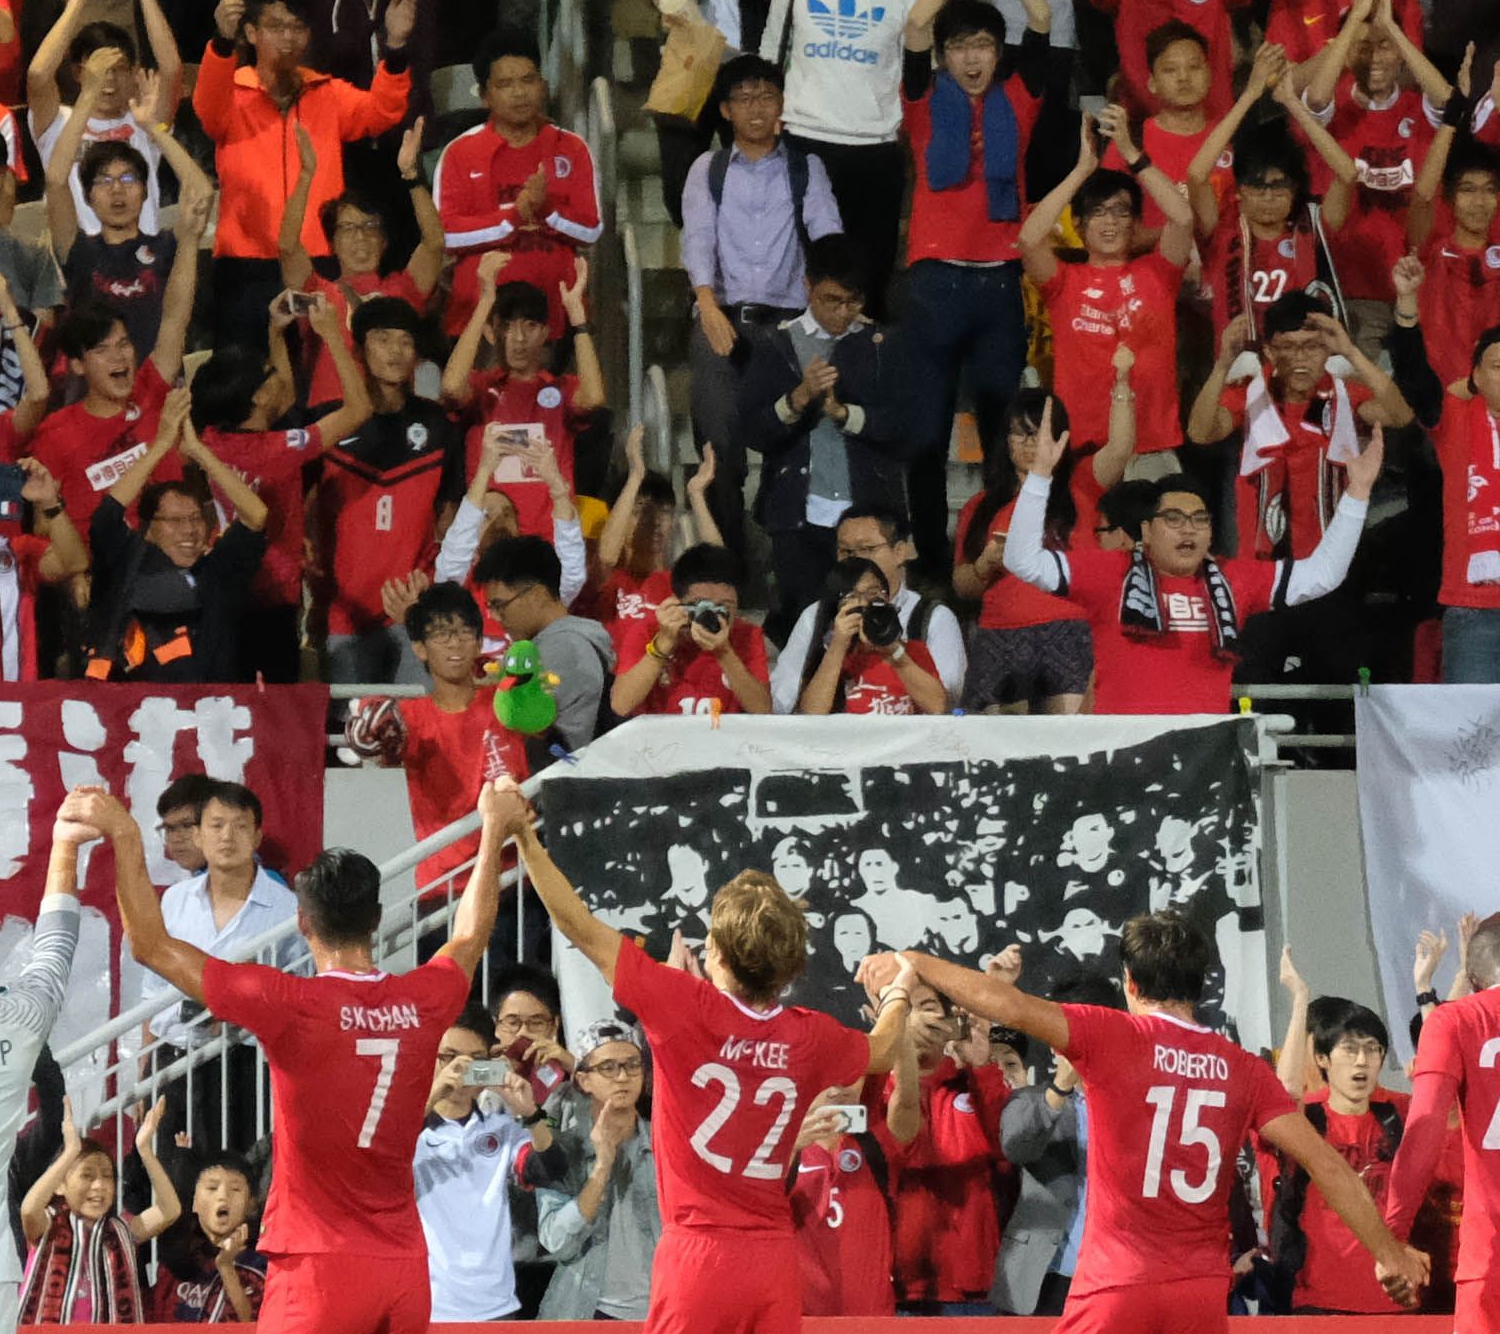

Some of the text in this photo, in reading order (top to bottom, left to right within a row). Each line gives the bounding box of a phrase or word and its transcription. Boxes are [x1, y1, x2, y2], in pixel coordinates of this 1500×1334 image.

[803, 42, 880, 65] adidas
[376, 495, 393, 531] 8
[354, 1037, 401, 1150] 7
[1153, 1043, 1229, 1082] ROBERTO
[689, 1060, 799, 1180] 22
[1143, 1084, 1228, 1205] 15
